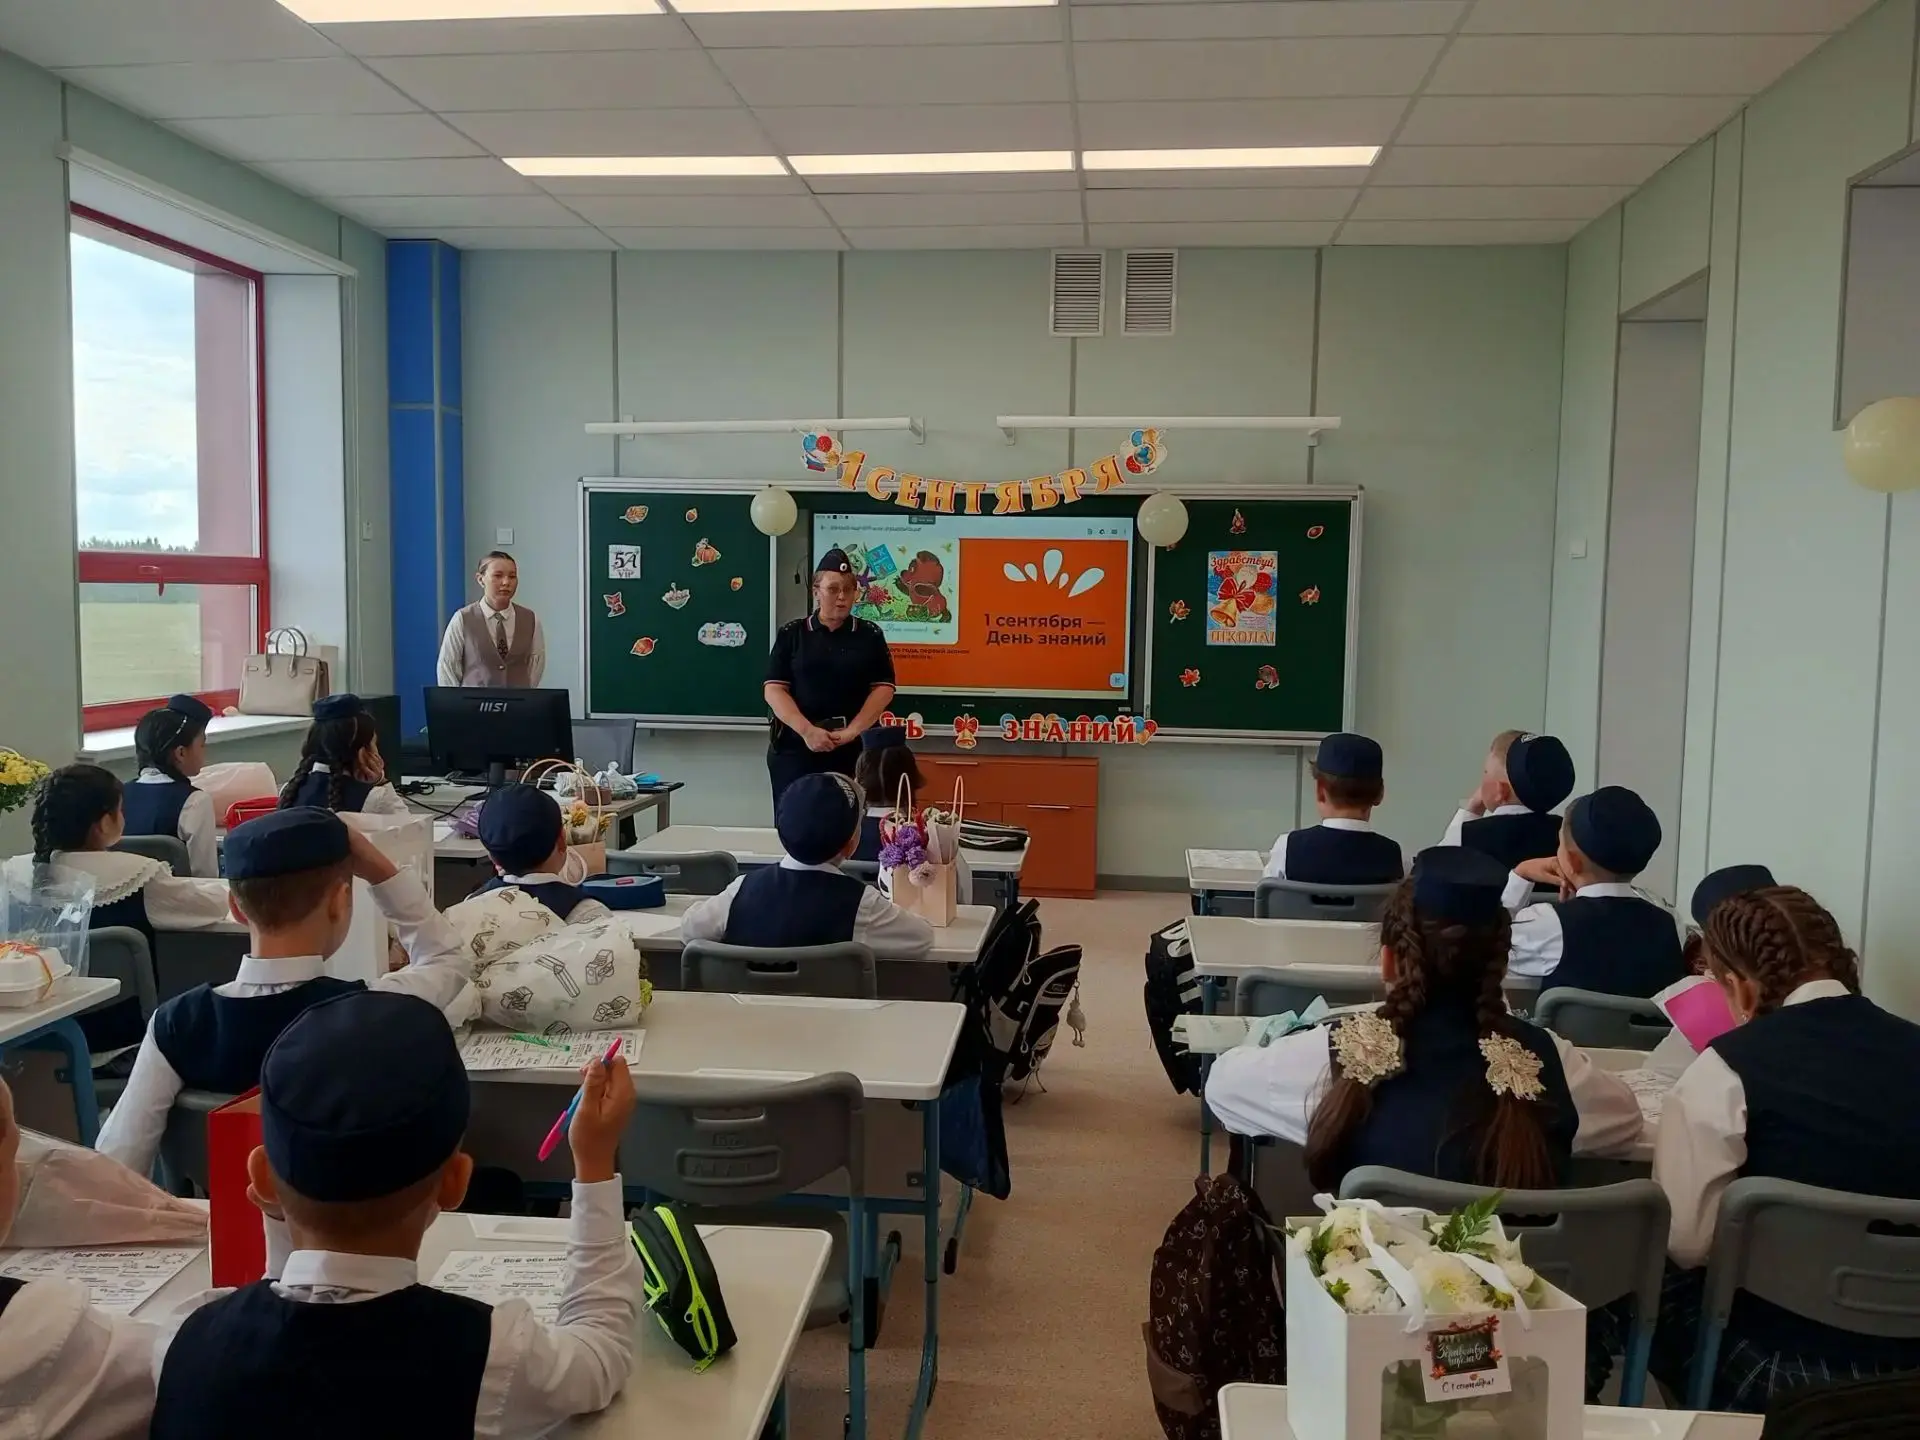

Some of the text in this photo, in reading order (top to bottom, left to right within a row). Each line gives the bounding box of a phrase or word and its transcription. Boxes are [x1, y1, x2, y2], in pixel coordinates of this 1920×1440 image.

[838, 450, 1126, 514] 1 СЕНТЯБРЯ
[983, 613, 991, 627] 1
[995, 614, 1082, 631] сентября
[986, 630, 1106, 646] День знаний
[480, 702, 507, 712] MSI
[1003, 716, 1135, 742] ЗНАНИЙ
